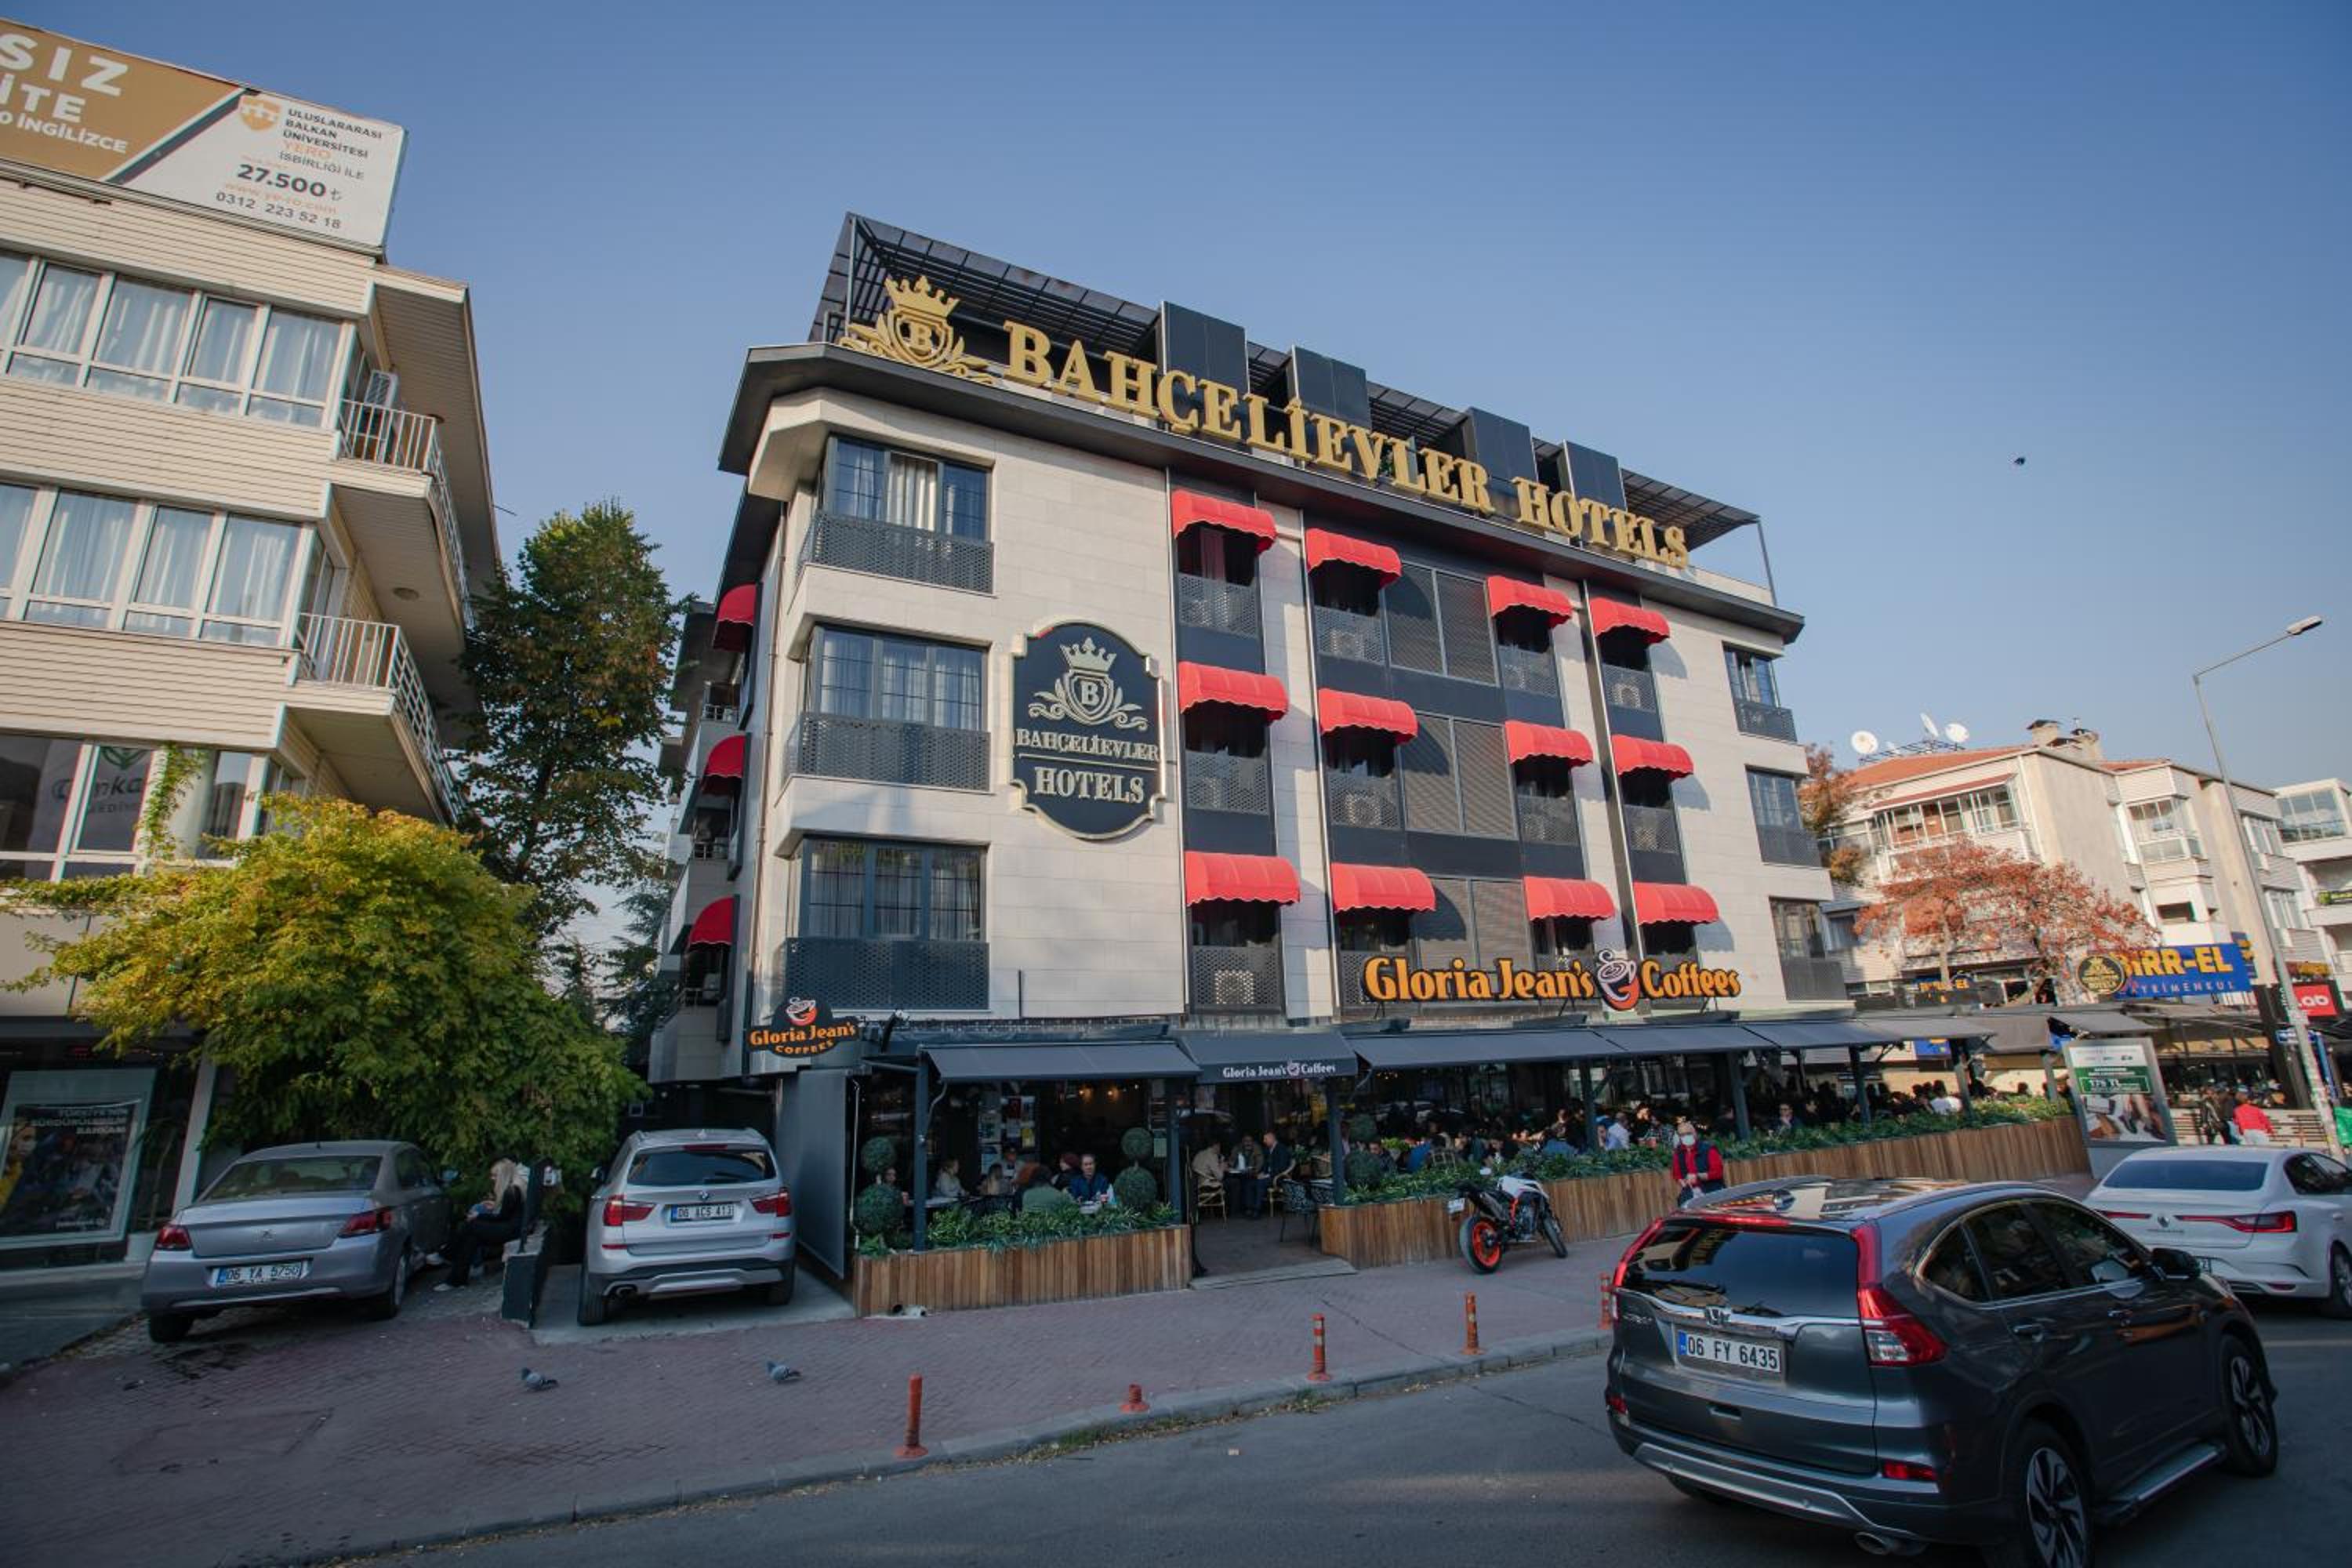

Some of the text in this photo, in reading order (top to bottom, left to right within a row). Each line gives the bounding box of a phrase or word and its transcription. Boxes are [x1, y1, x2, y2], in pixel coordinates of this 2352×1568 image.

[285, 118, 338, 139] BALKAN
[237, 163, 327, 198] 27.500
[216, 191, 341, 230] 0312 223 52 18
[1004, 319, 1690, 570] BAHÇELİEVLER HOTELS
[1033, 766, 1145, 804] HOTELS
[1363, 955, 1741, 1002] Gloria Jean's Coffees
[750, 1022, 856, 1046] Gloria Jean's
[1222, 1062, 1337, 1079] Gloria Jean's Coffees
[1688, 1336, 1704, 1356] 06
[1714, 1340, 1731, 1361] FY
[1738, 1345, 1778, 1370] 6435
